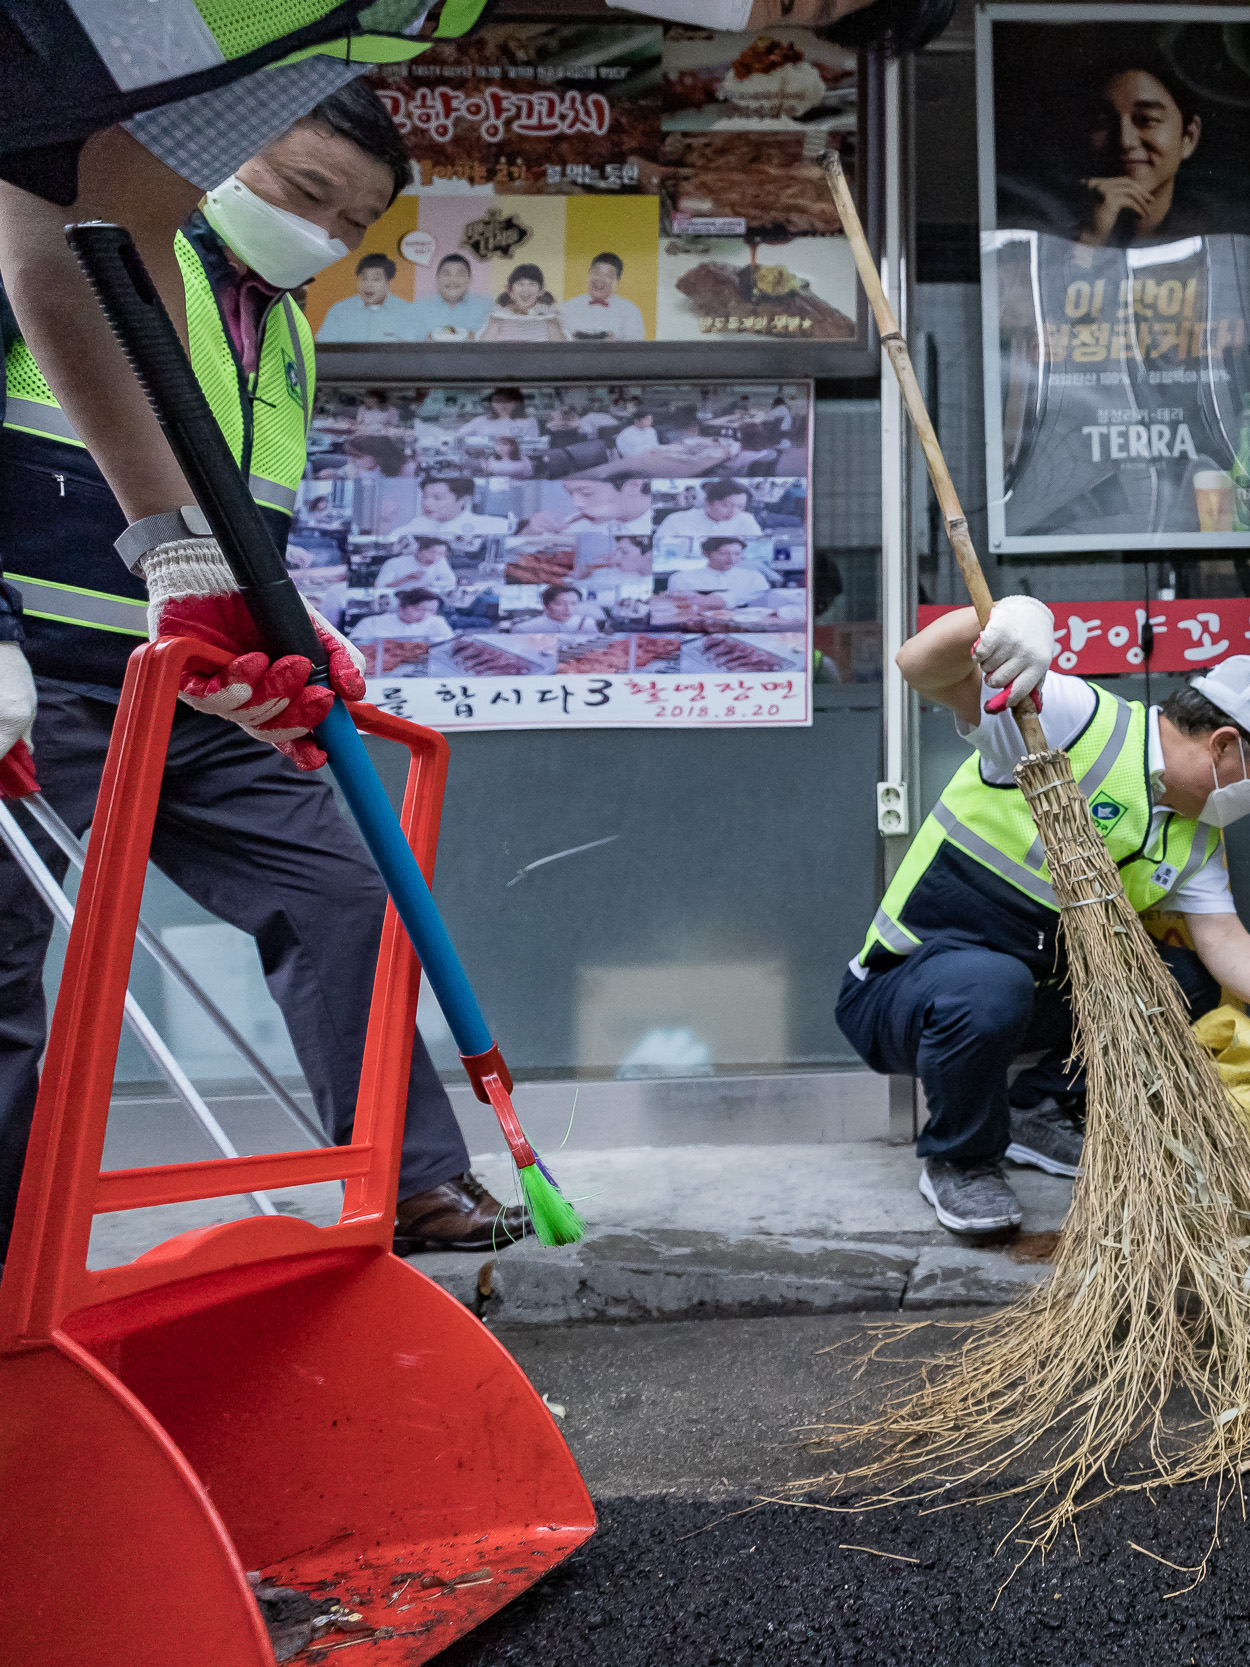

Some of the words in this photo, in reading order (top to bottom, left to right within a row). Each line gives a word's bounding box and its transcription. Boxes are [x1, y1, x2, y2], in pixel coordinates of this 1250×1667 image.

[1064, 278, 1105, 319] 이
[1081, 423, 1199, 463] TERRA
[655, 704, 781, 718] 2018.8.20
